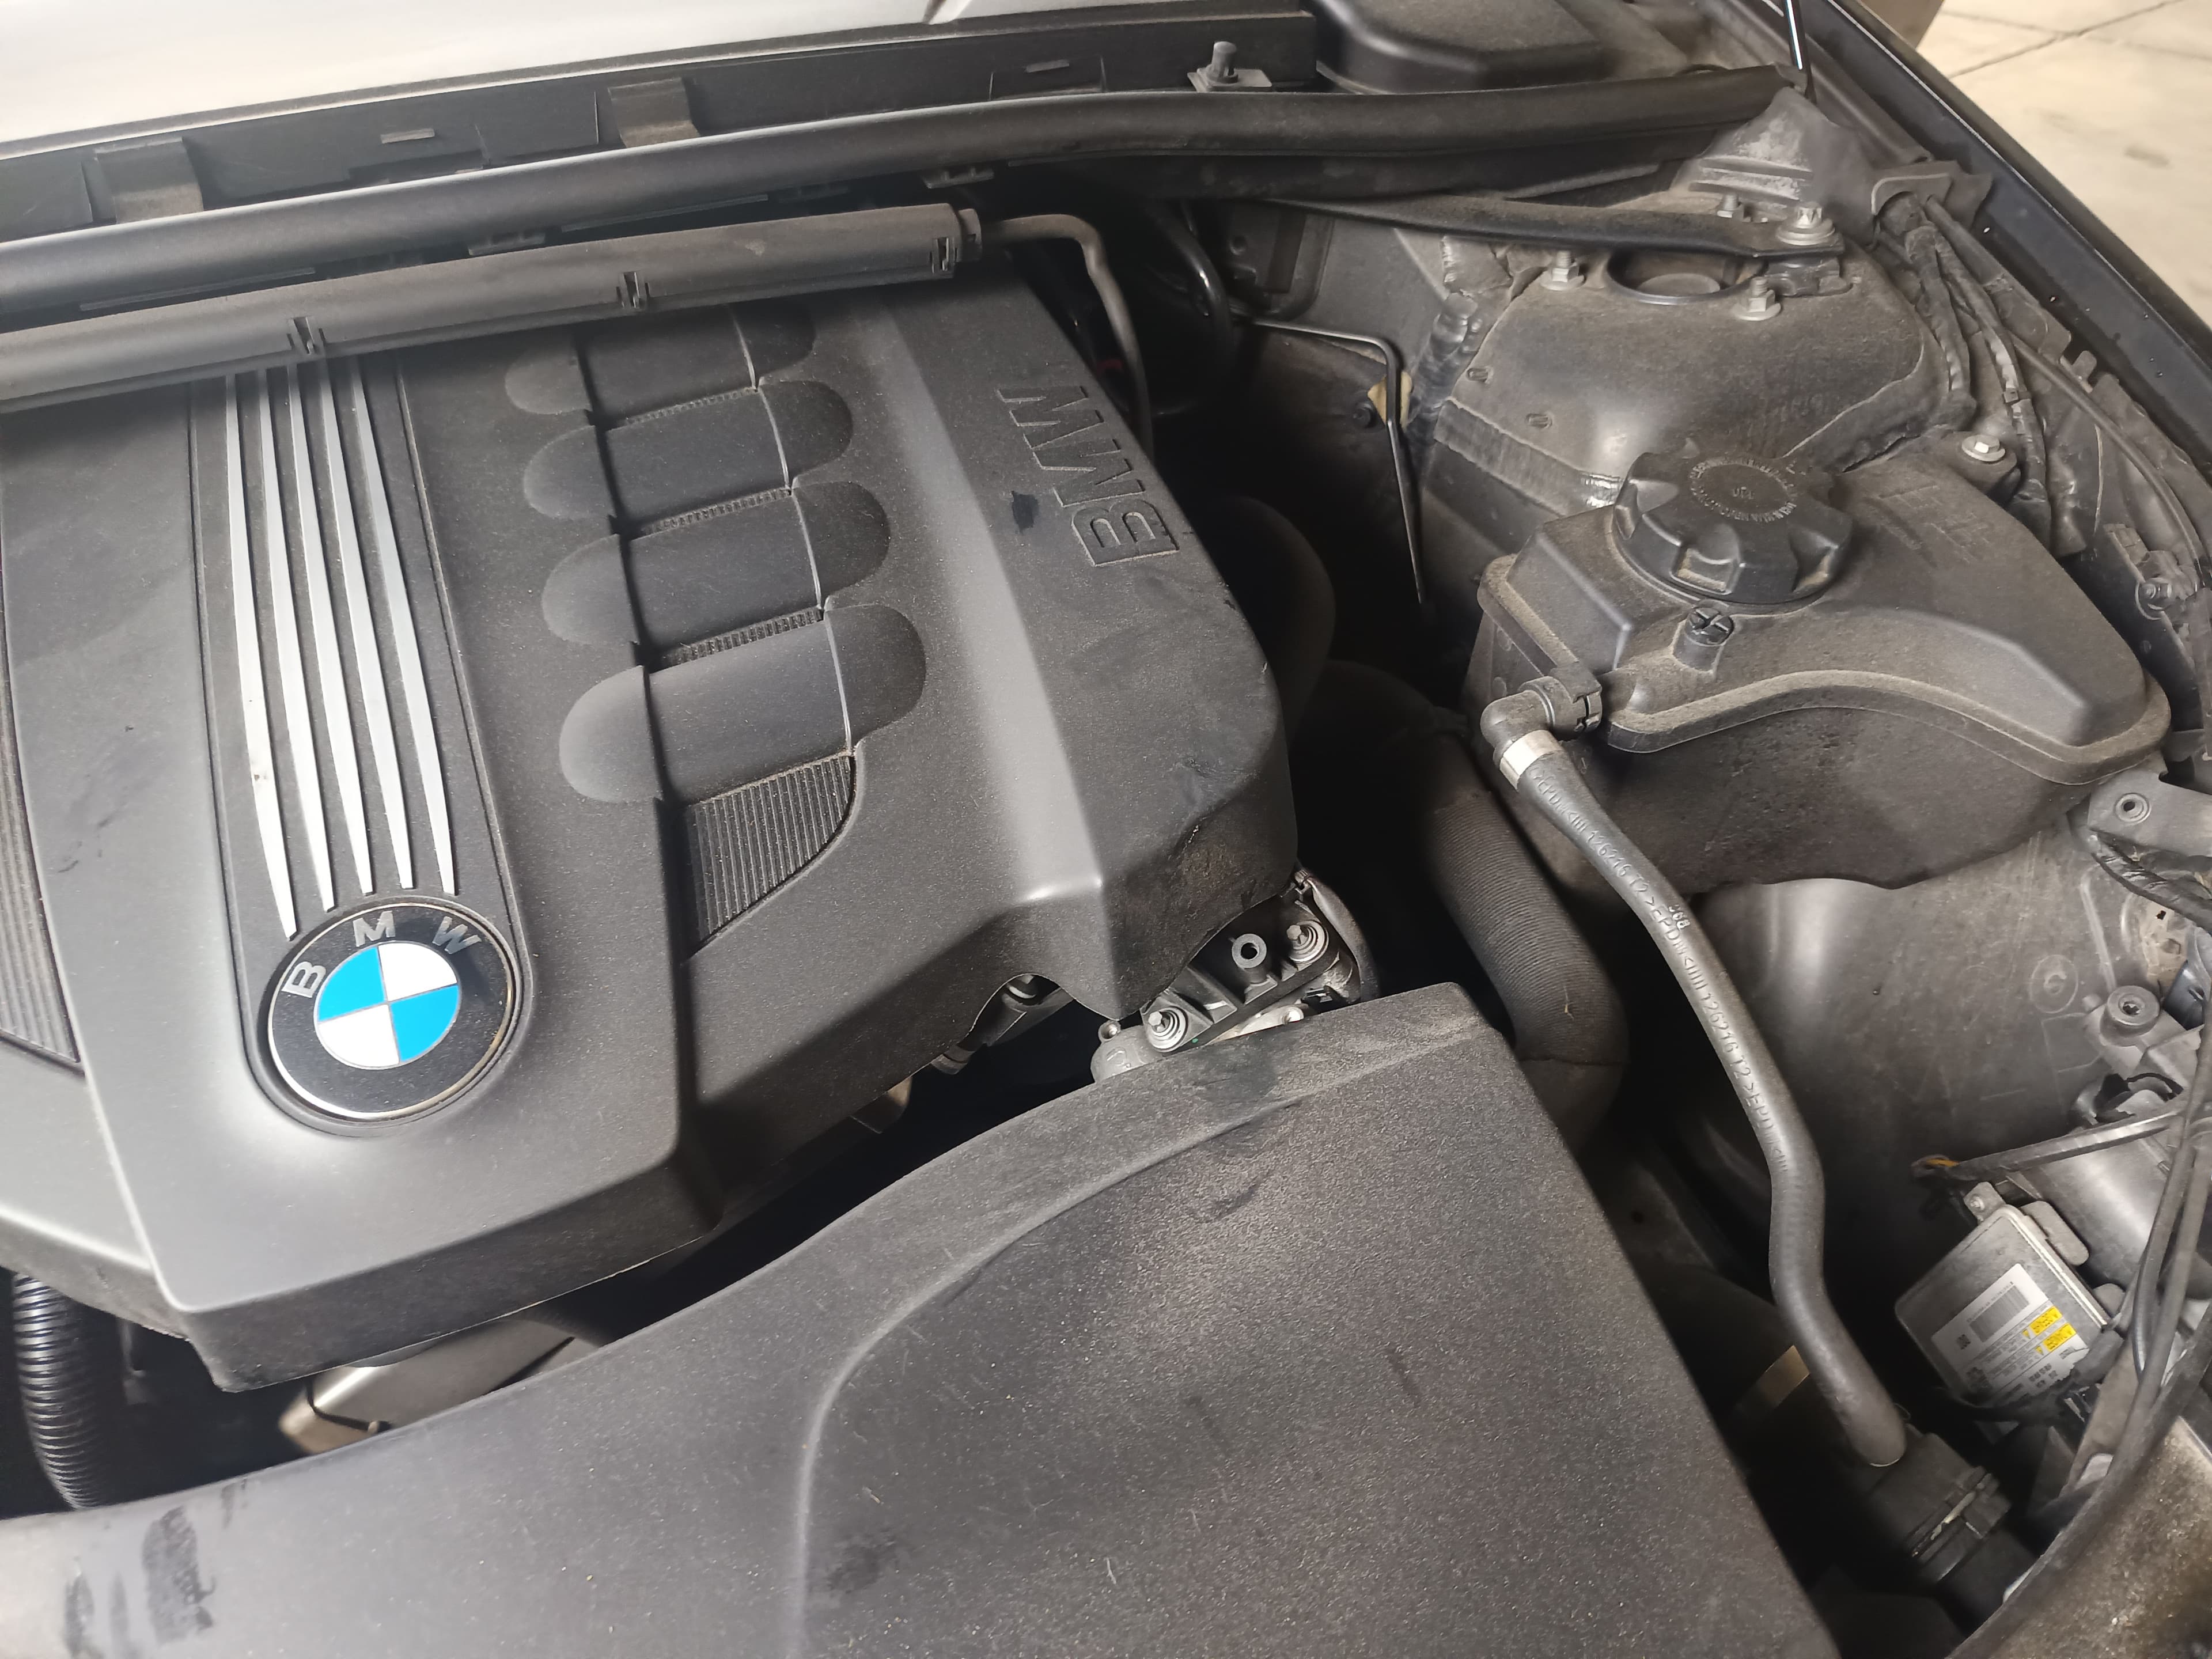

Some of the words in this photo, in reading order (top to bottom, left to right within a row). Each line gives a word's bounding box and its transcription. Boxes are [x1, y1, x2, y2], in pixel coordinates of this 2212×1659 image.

[997, 385, 1180, 567] BMW
[281, 910, 482, 998] BMW
[1701, 993, 1737, 1052] 126216
